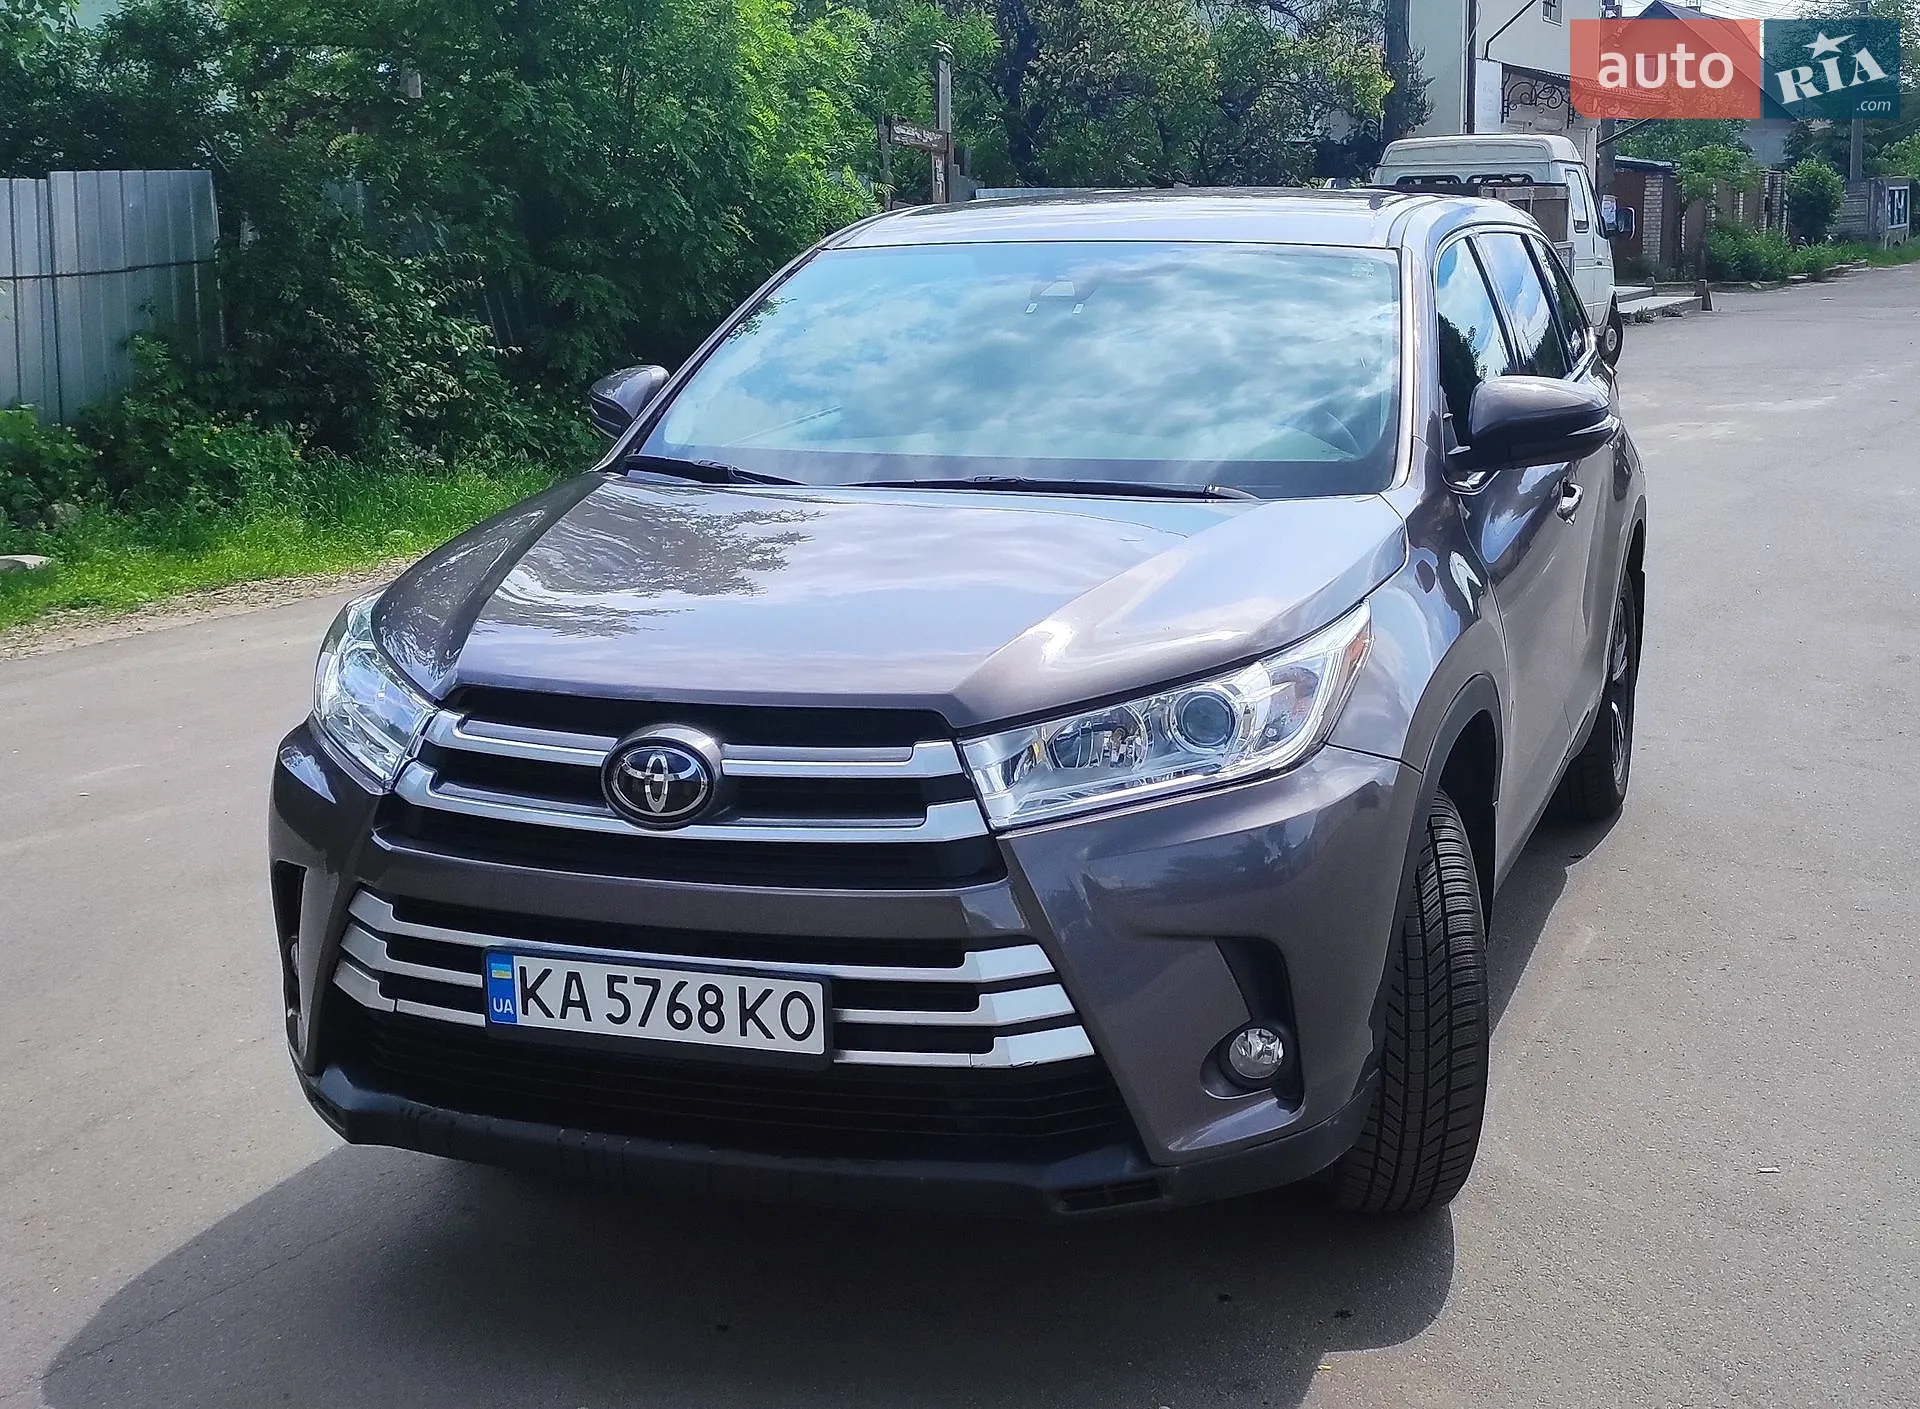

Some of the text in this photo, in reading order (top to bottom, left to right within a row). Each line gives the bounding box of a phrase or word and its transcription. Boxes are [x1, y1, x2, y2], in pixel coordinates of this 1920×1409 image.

[492, 997, 515, 1015] UA
[519, 965, 816, 1042] KA 5768 KO
